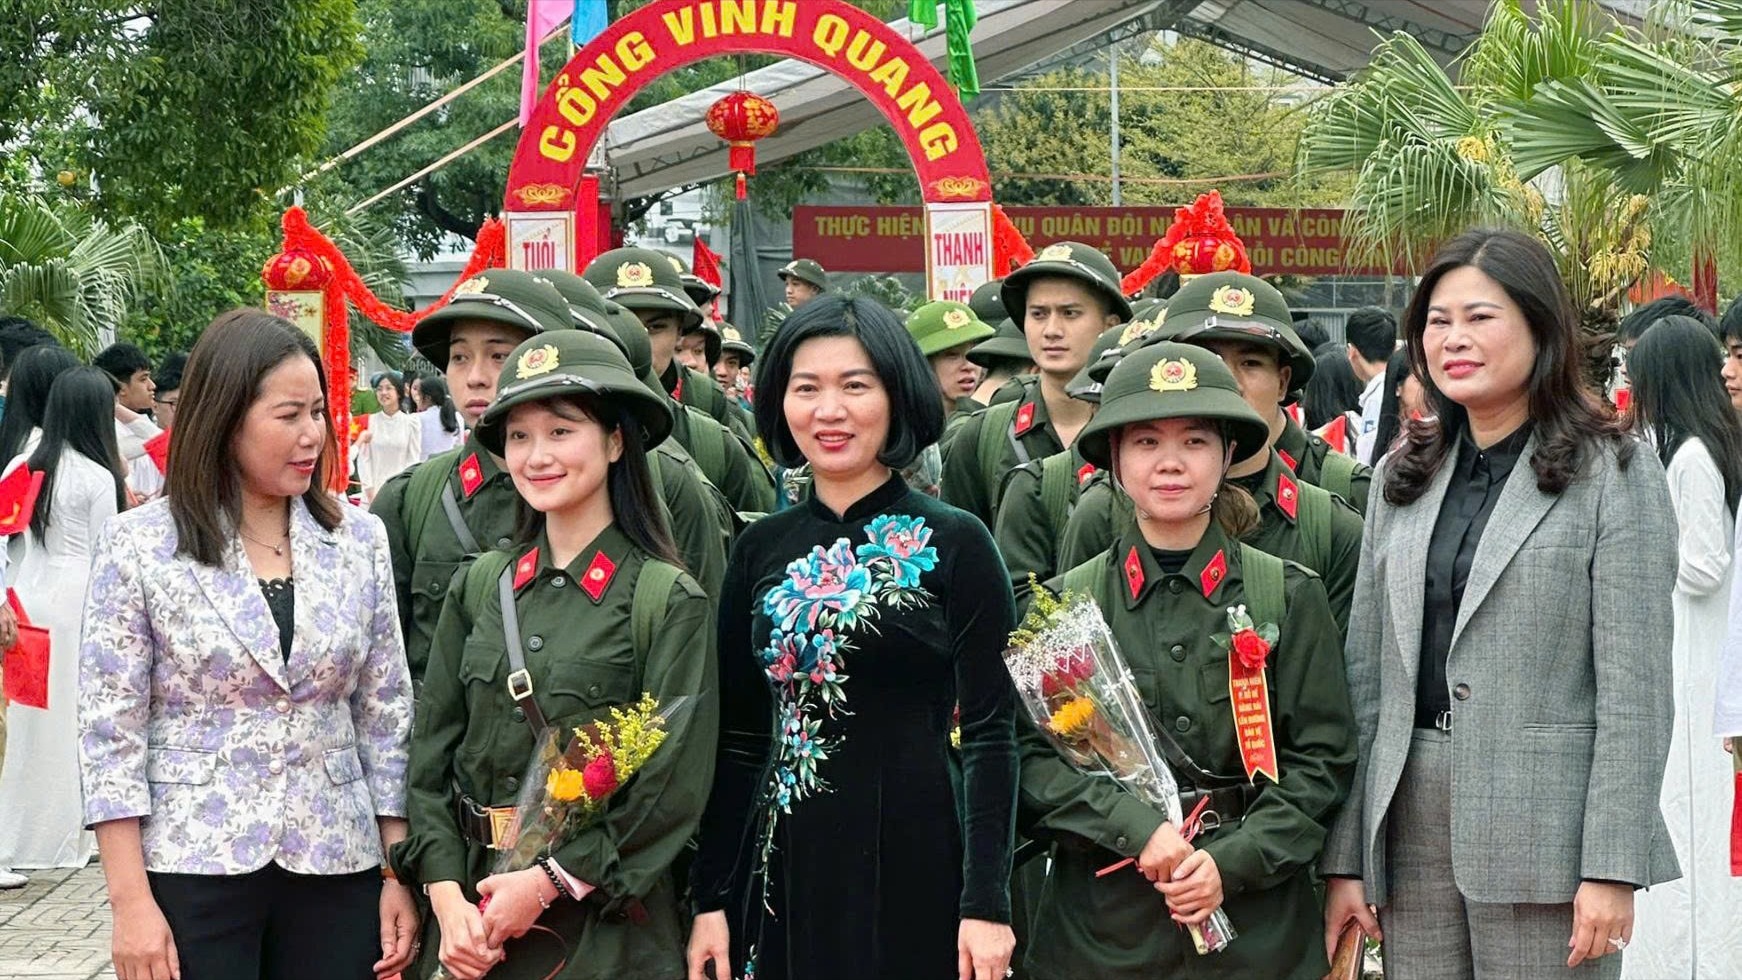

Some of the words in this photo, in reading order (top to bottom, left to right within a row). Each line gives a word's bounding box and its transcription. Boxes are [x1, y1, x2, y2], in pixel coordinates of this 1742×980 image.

[539, 30, 657, 162] CỔNG
[662, 0, 797, 46] VINH
[812, 14, 959, 162] QUANG
[815, 214, 871, 240] THỰC
[876, 212, 925, 240] HIỆN
[1041, 213, 1100, 238] QUÂN
[1106, 212, 1143, 240] ĐỘI
[1230, 213, 1262, 237] ÂN
[1267, 213, 1295, 237] VÀ
[1302, 213, 1350, 237] CÔN
[522, 227, 556, 272] TUỔI
[934, 232, 984, 267] THANH
[1280, 243, 1339, 267] CÔNG
